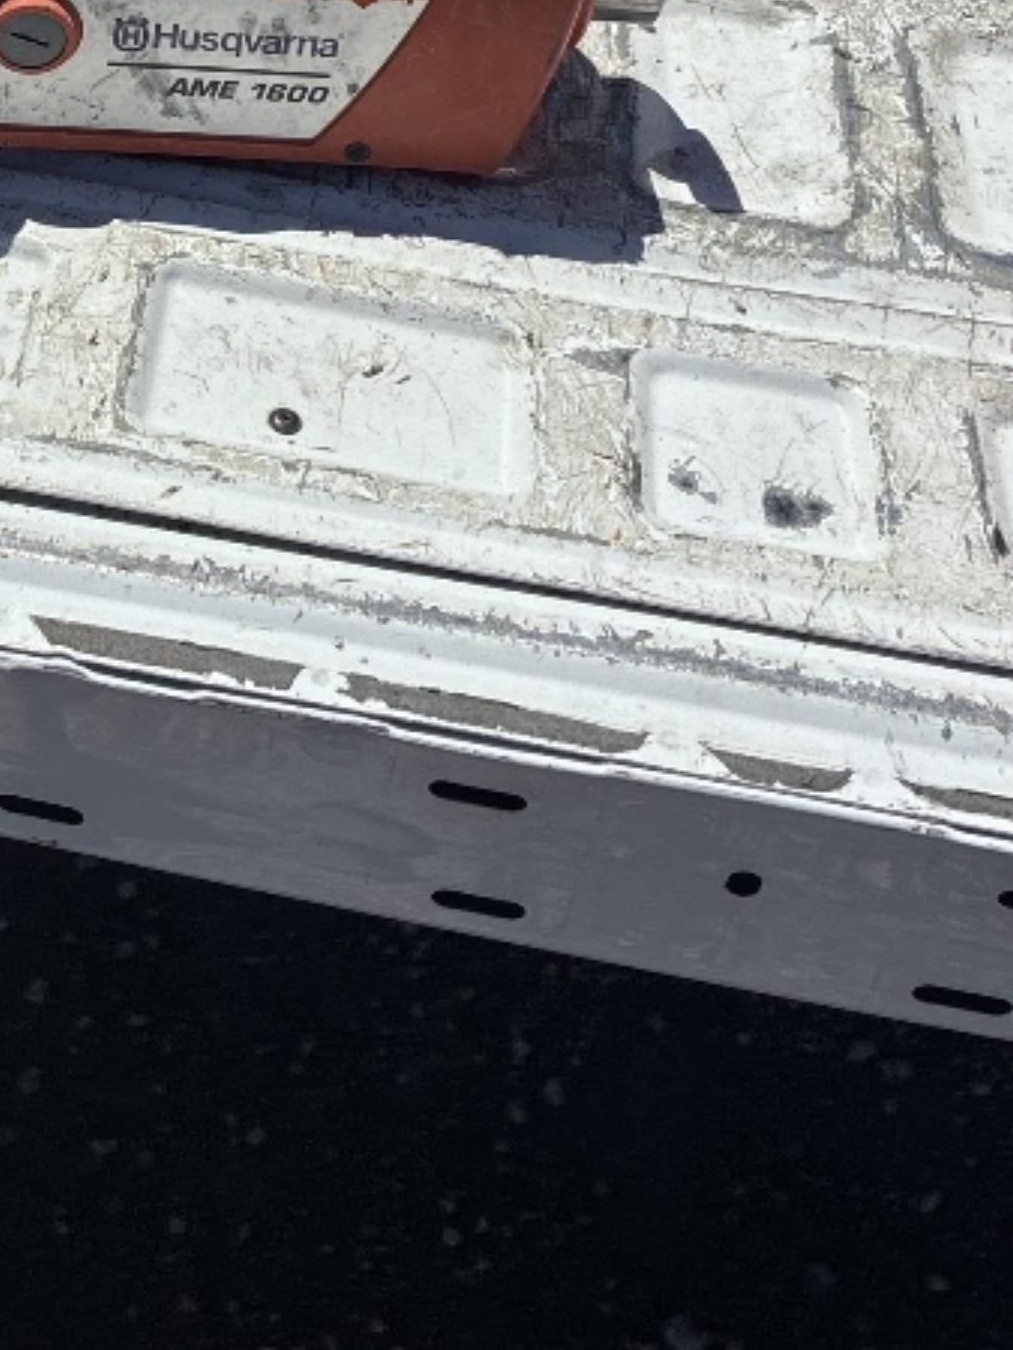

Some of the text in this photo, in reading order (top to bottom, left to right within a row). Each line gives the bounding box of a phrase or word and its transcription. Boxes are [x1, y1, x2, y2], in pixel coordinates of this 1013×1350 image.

[152, 23, 339, 58] Husqvarna
[167, 77, 330, 104] AME 1600
